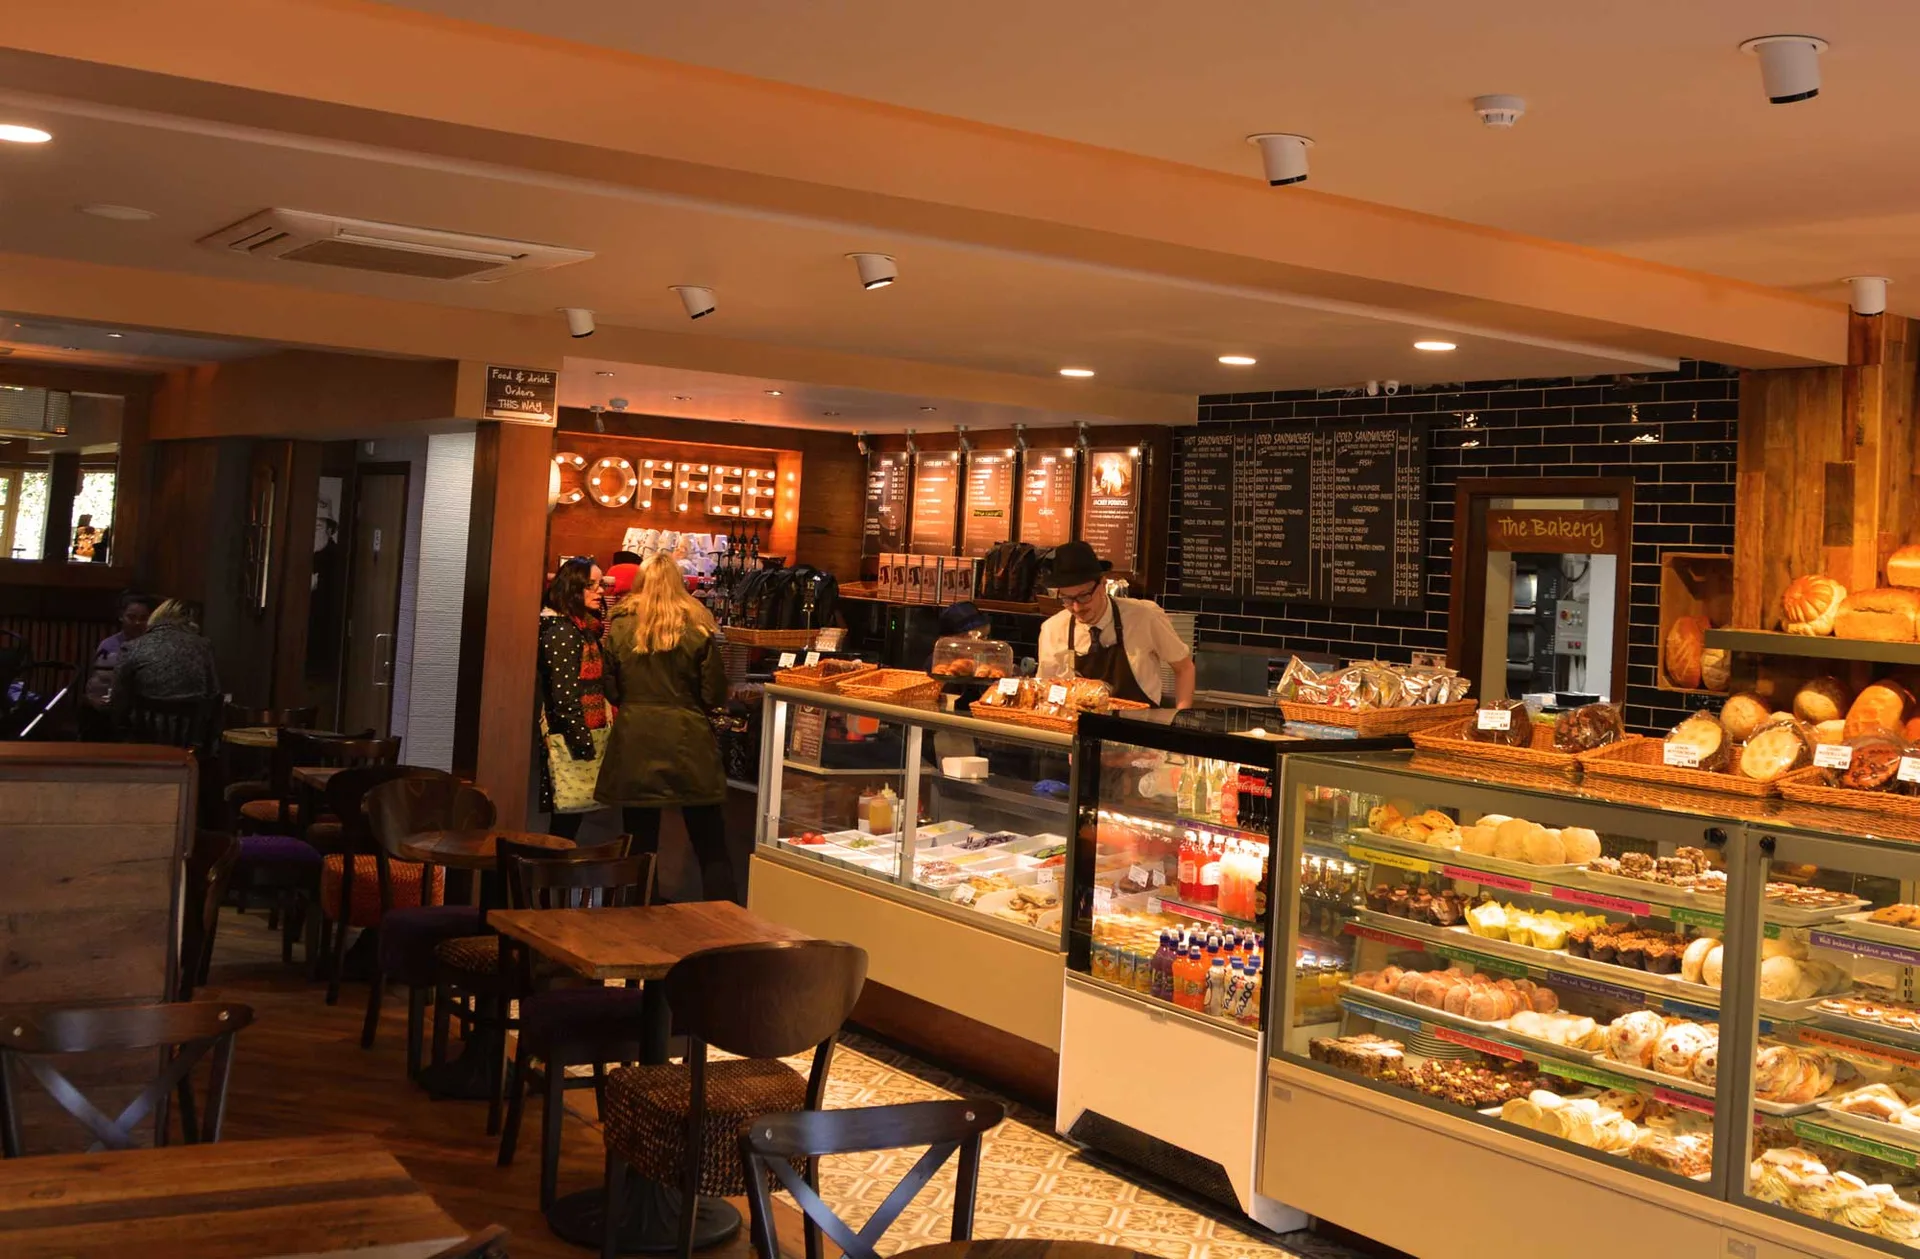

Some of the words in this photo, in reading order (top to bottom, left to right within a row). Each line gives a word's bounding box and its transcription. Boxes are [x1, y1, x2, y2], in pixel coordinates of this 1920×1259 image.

[492, 370, 512, 380] Food
[516, 372, 524, 383] &
[528, 373, 550, 384] drink
[505, 385, 535, 397] Orders
[498, 399, 519, 409] THIS
[1256, 434, 1272, 445] COLD
[1274, 432, 1311, 445] SANDWICHES
[1336, 431, 1353, 443] COLD
[1355, 430, 1396, 442] SANDWICHES
[551, 452, 775, 519] COFFEE
[1498, 516, 1528, 536] The
[1531, 517, 1604, 548] Bakery
